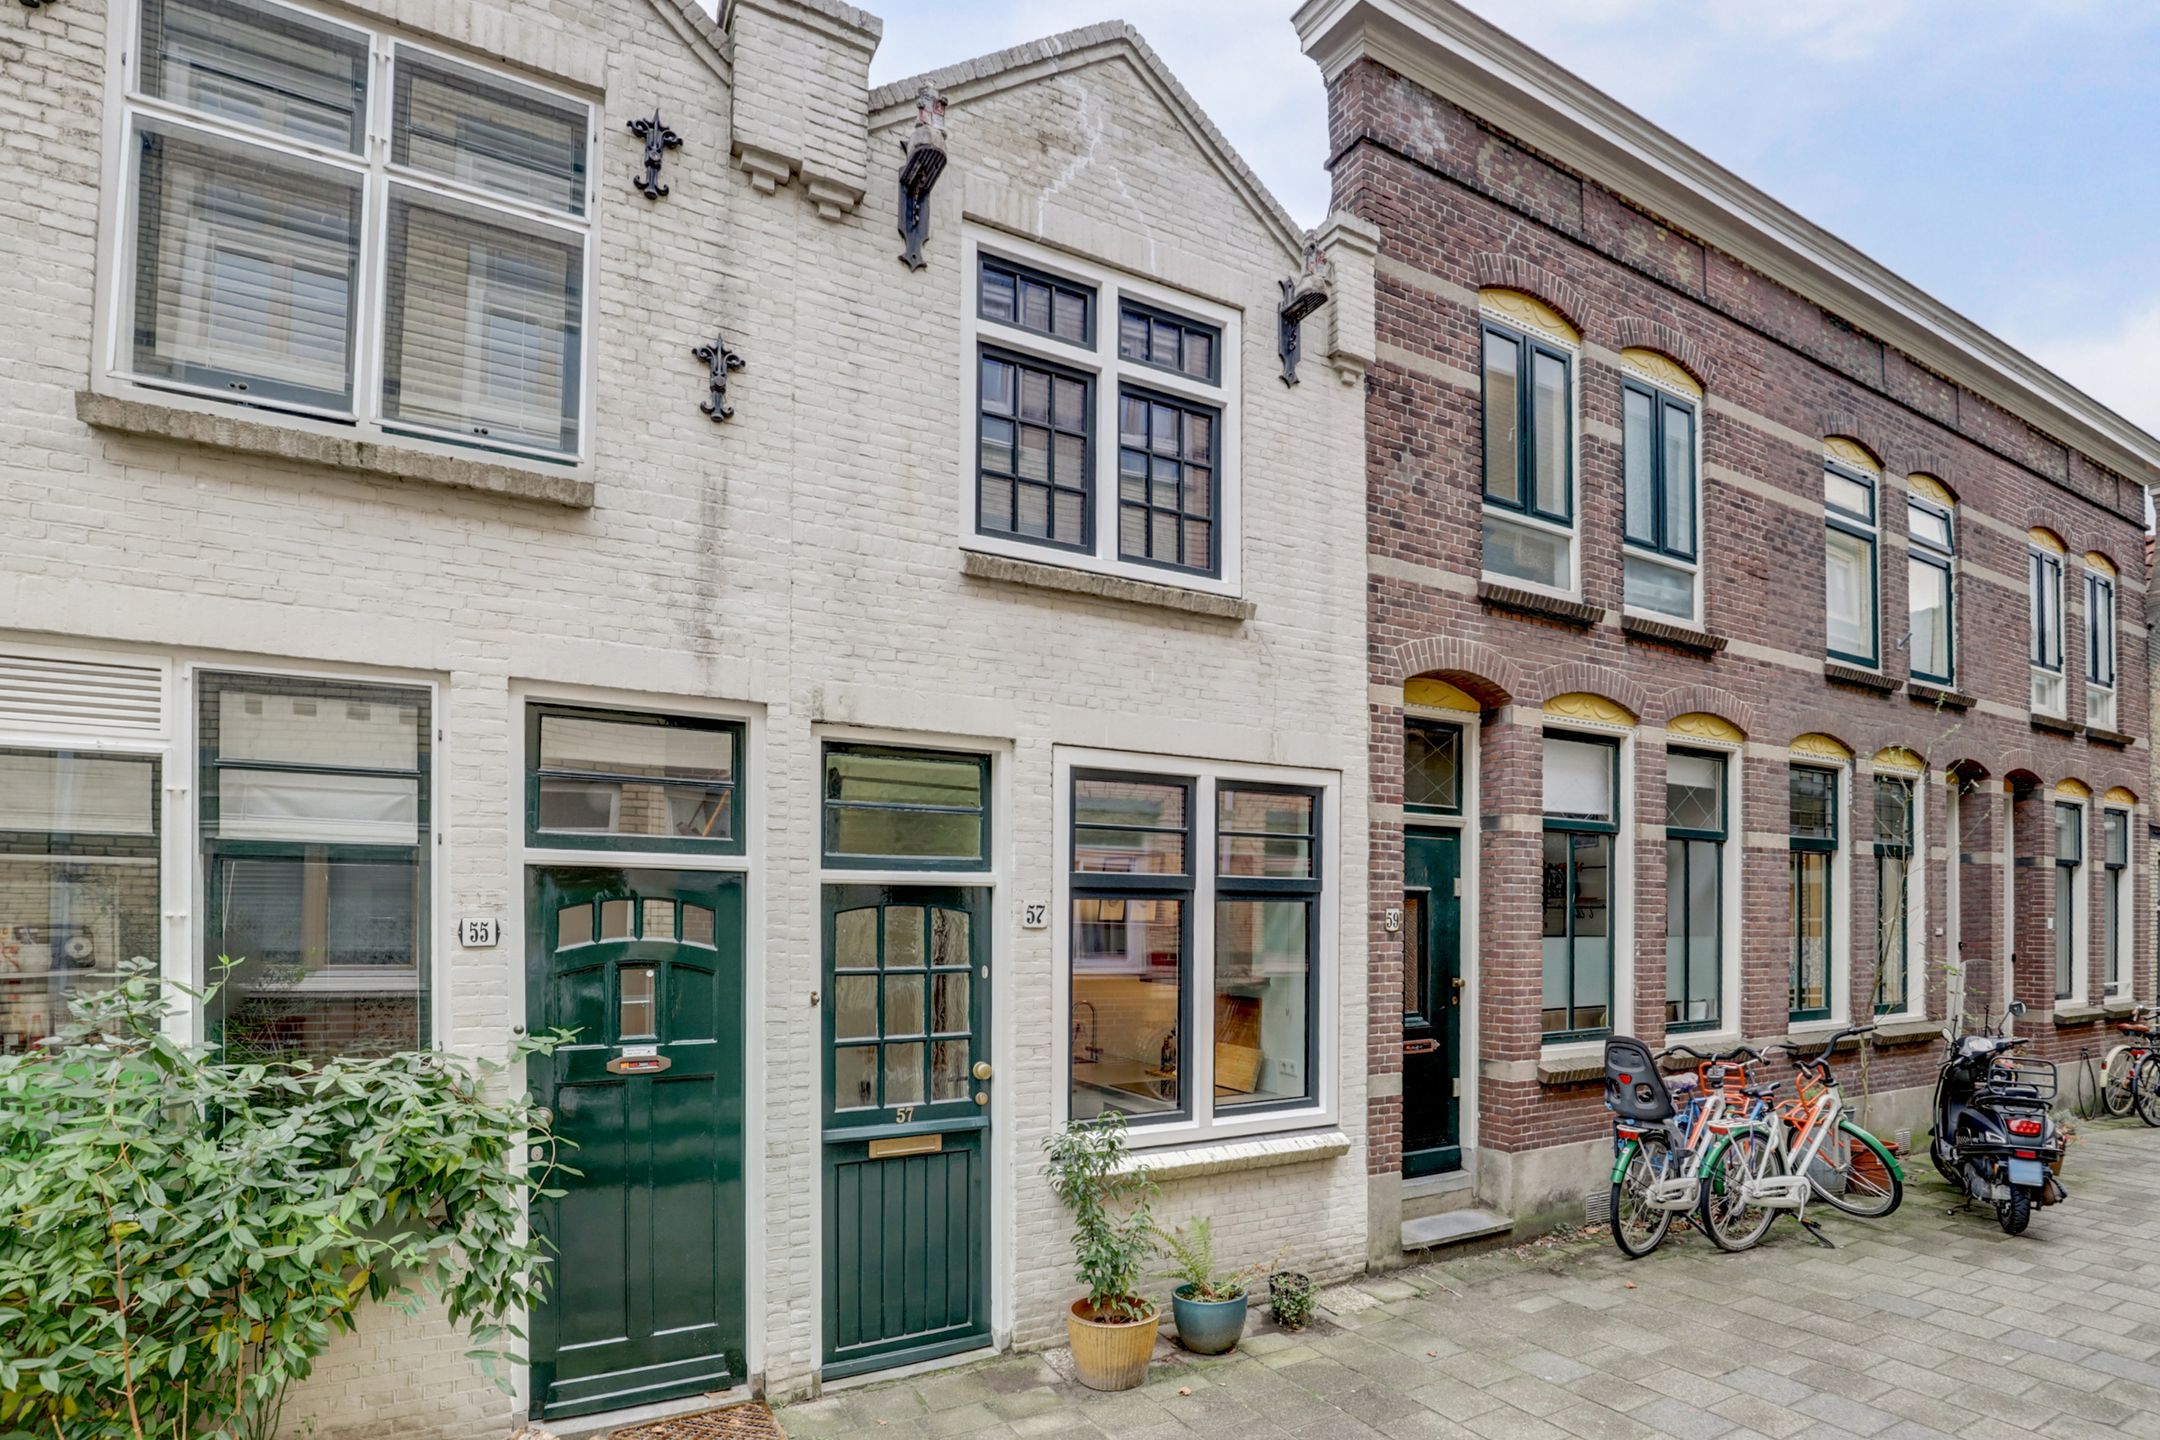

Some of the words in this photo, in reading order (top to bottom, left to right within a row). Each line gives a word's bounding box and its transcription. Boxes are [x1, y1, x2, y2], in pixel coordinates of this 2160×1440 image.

[1026, 904, 1046, 924] 57
[1386, 911, 1399, 928] 59
[469, 921, 489, 943] 55
[896, 1106, 914, 1124] 57
